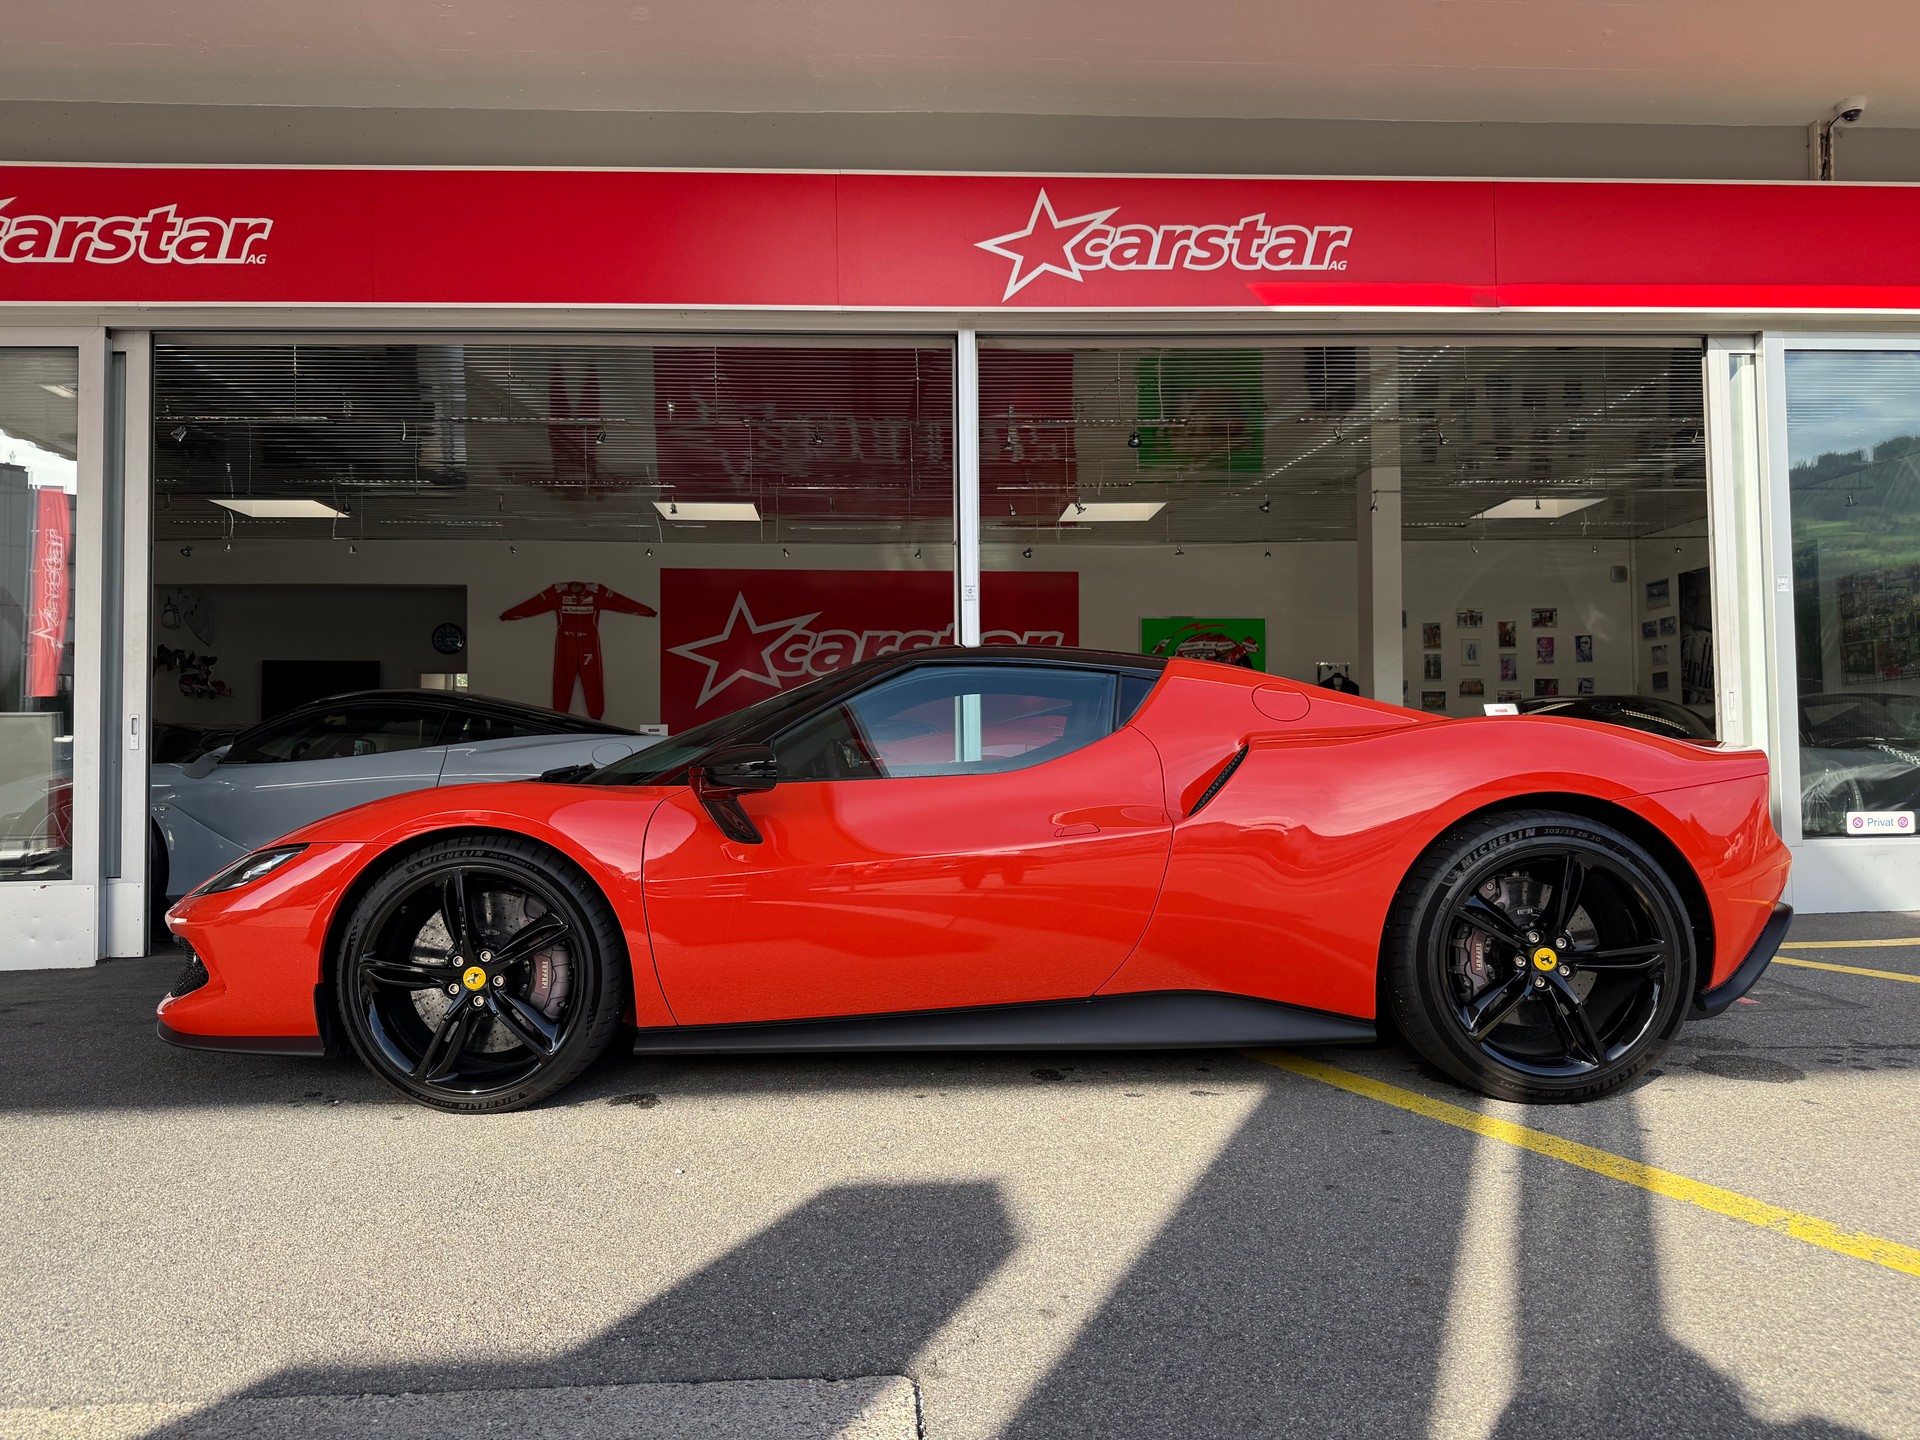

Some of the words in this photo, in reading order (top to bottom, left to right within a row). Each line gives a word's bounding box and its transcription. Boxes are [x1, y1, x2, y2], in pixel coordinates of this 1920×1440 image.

[0, 204, 273, 264] arstar
[246, 254, 267, 264] AG
[1074, 213, 1352, 271] carstar
[1328, 260, 1348, 271] AG
[584, 653, 593, 666] 7
[1867, 817, 1894, 827] Privat
[422, 850, 485, 867] MICHELIN
[488, 852, 509, 860] PILOT
[1460, 828, 1536, 870] MICHELIN
[1544, 827, 1575, 836] 305/35
[1576, 830, 1588, 838] ZR
[1590, 834, 1602, 843] 20
[1572, 1056, 1647, 1097] MICHELIN
[458, 1094, 520, 1110] MICHELIN
